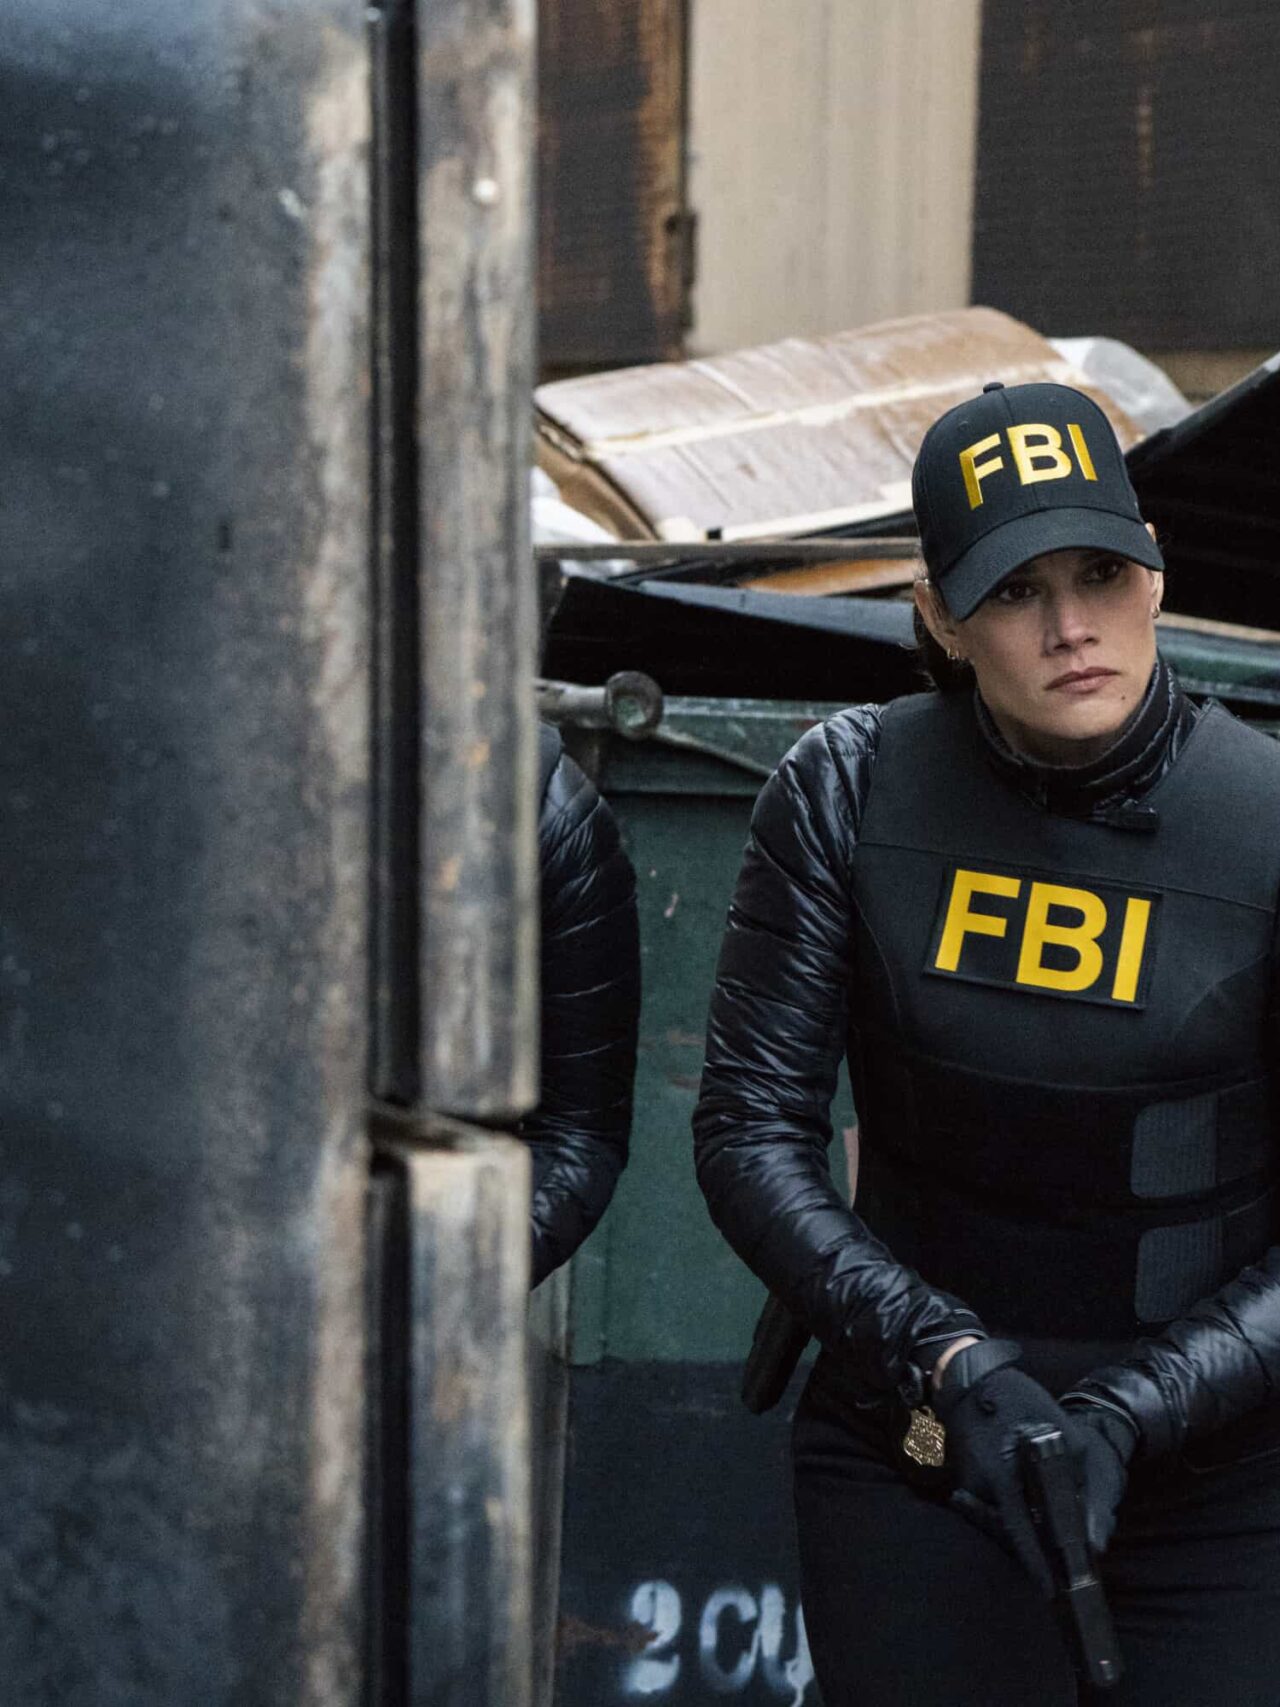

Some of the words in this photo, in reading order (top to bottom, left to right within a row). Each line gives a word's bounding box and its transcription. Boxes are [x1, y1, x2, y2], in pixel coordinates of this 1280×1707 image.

[958, 422, 1099, 510] FBI
[934, 868, 1152, 1003] FBI
[628, 1578, 682, 1694] 2
